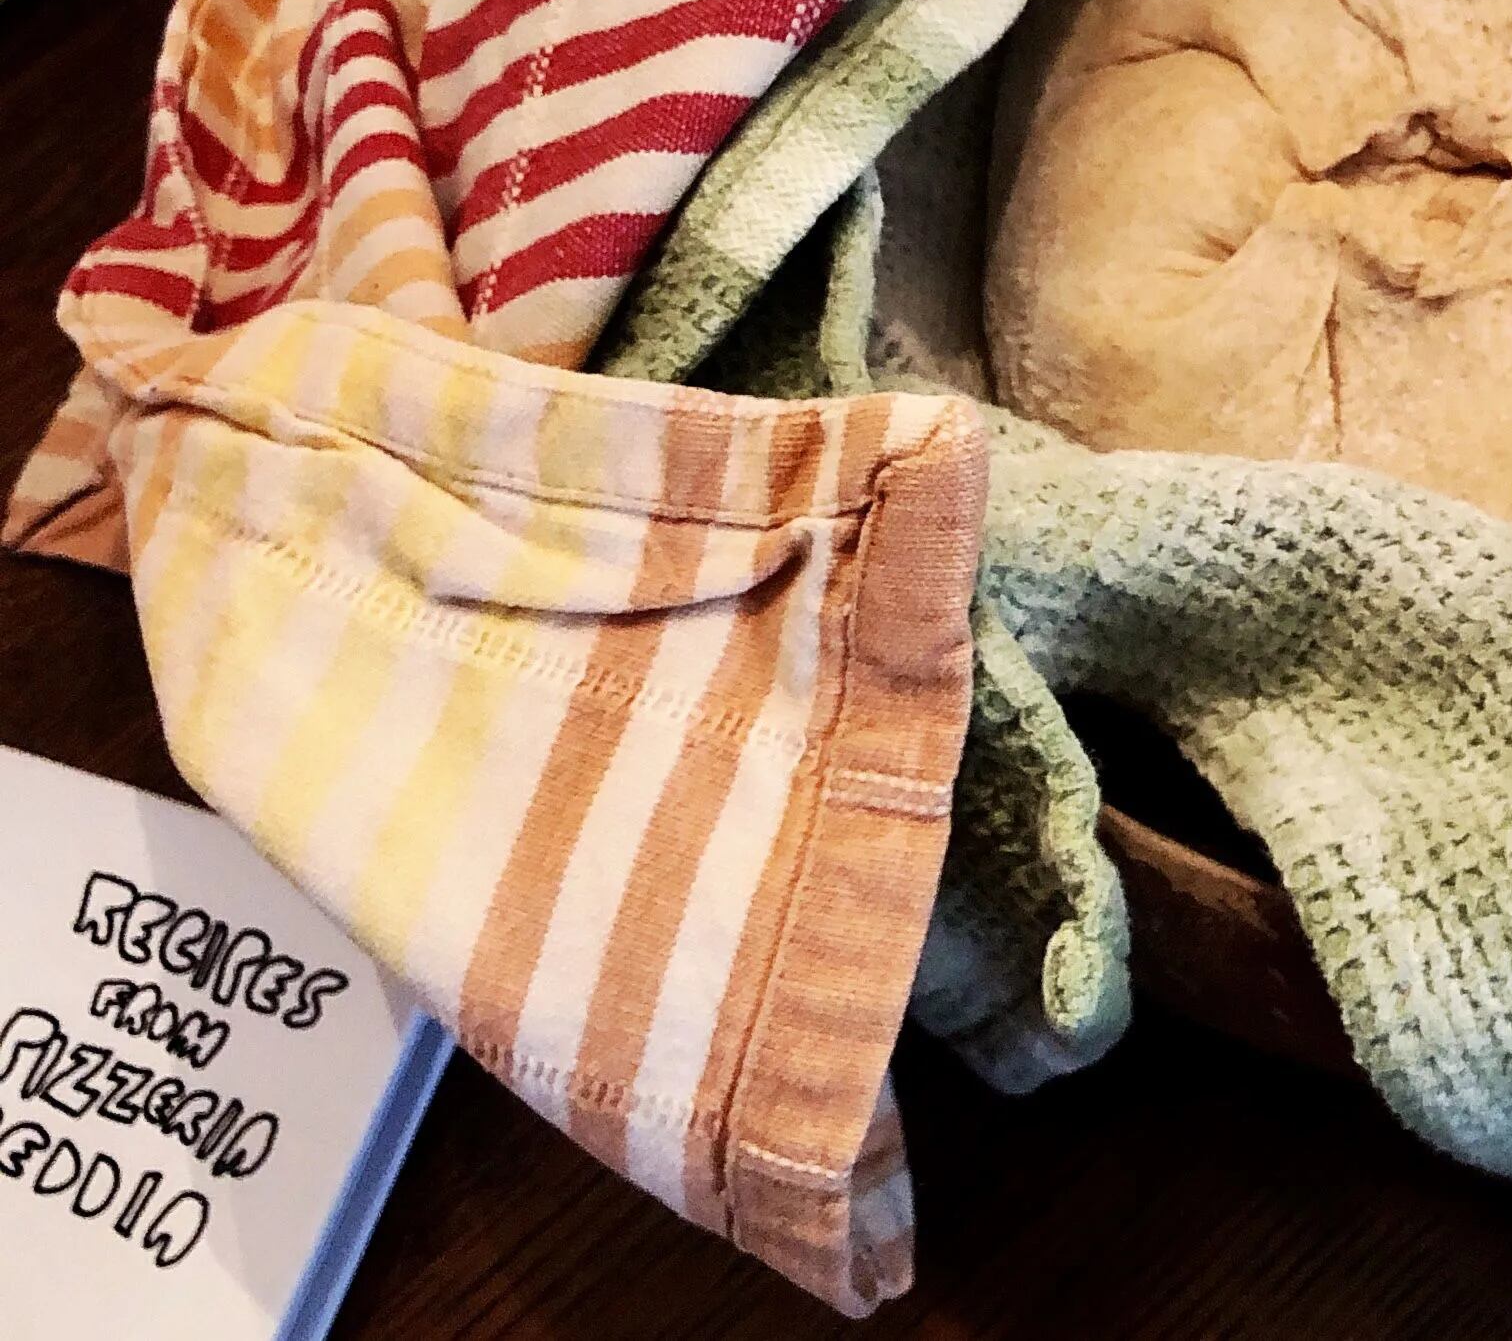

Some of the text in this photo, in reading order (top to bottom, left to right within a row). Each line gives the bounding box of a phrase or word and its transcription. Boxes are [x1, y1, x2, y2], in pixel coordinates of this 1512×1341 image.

[73, 870, 350, 1030] RECIPES
[90, 977, 232, 1071] FROM
[0, 1007, 281, 1181] PIZZERIA
[0, 1105, 212, 1270] EDDIA
